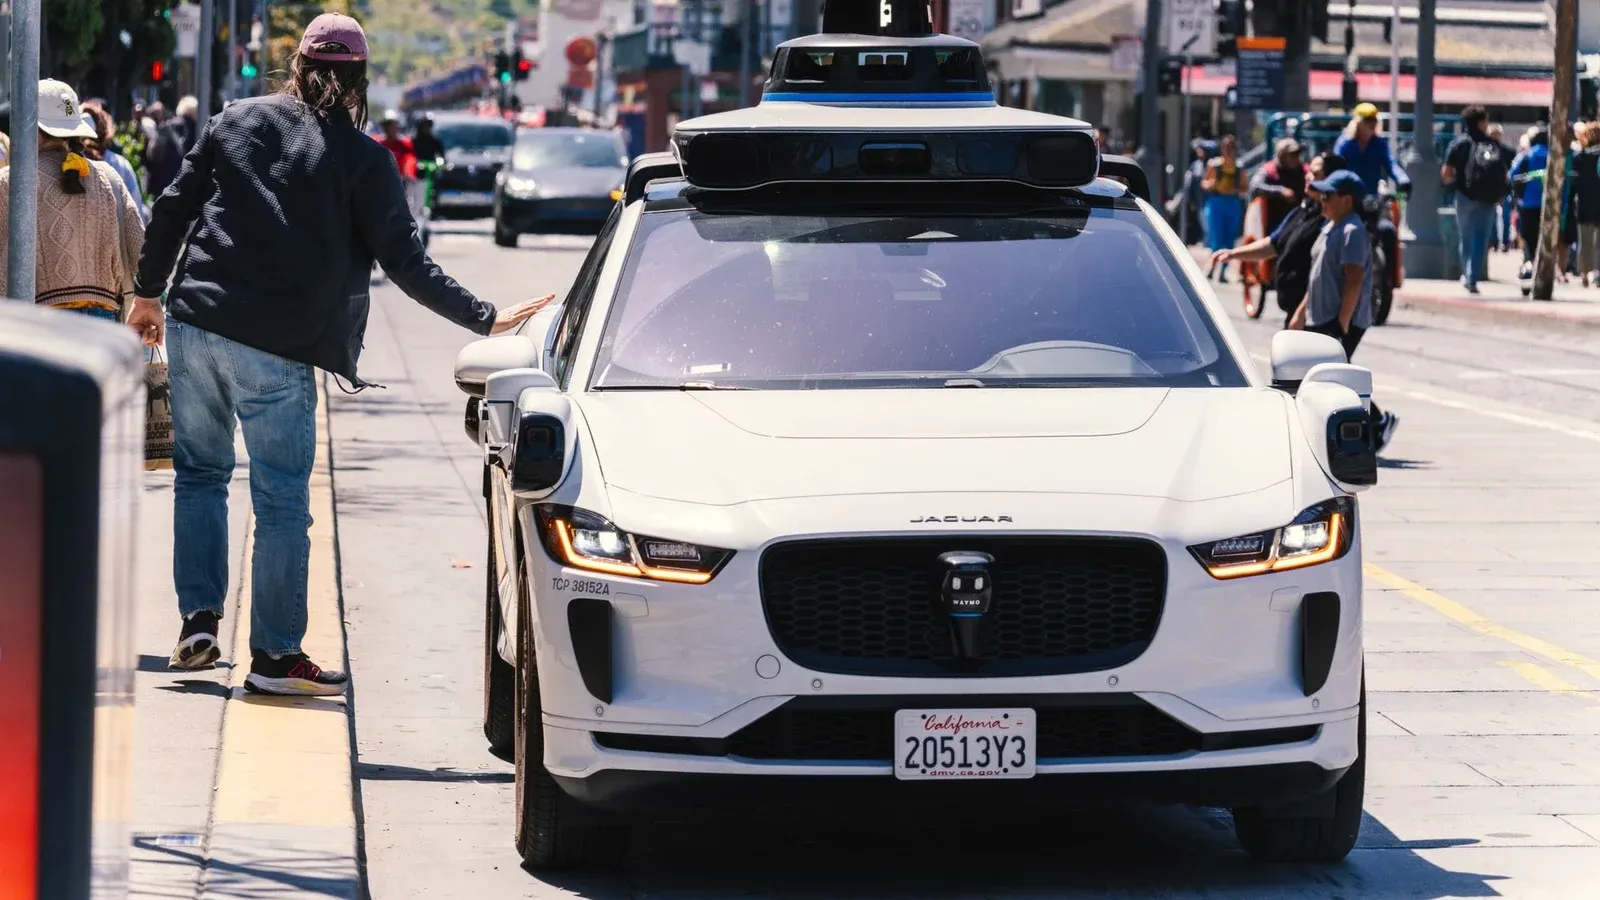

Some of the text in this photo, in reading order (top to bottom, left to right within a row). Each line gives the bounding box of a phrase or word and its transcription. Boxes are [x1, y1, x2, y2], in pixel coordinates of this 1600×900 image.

[910, 515, 1013, 523] JAGUAR
[552, 578, 610, 595] TCP 38152A
[924, 714, 1010, 735] California
[905, 735, 1026, 769] 20513Y3
